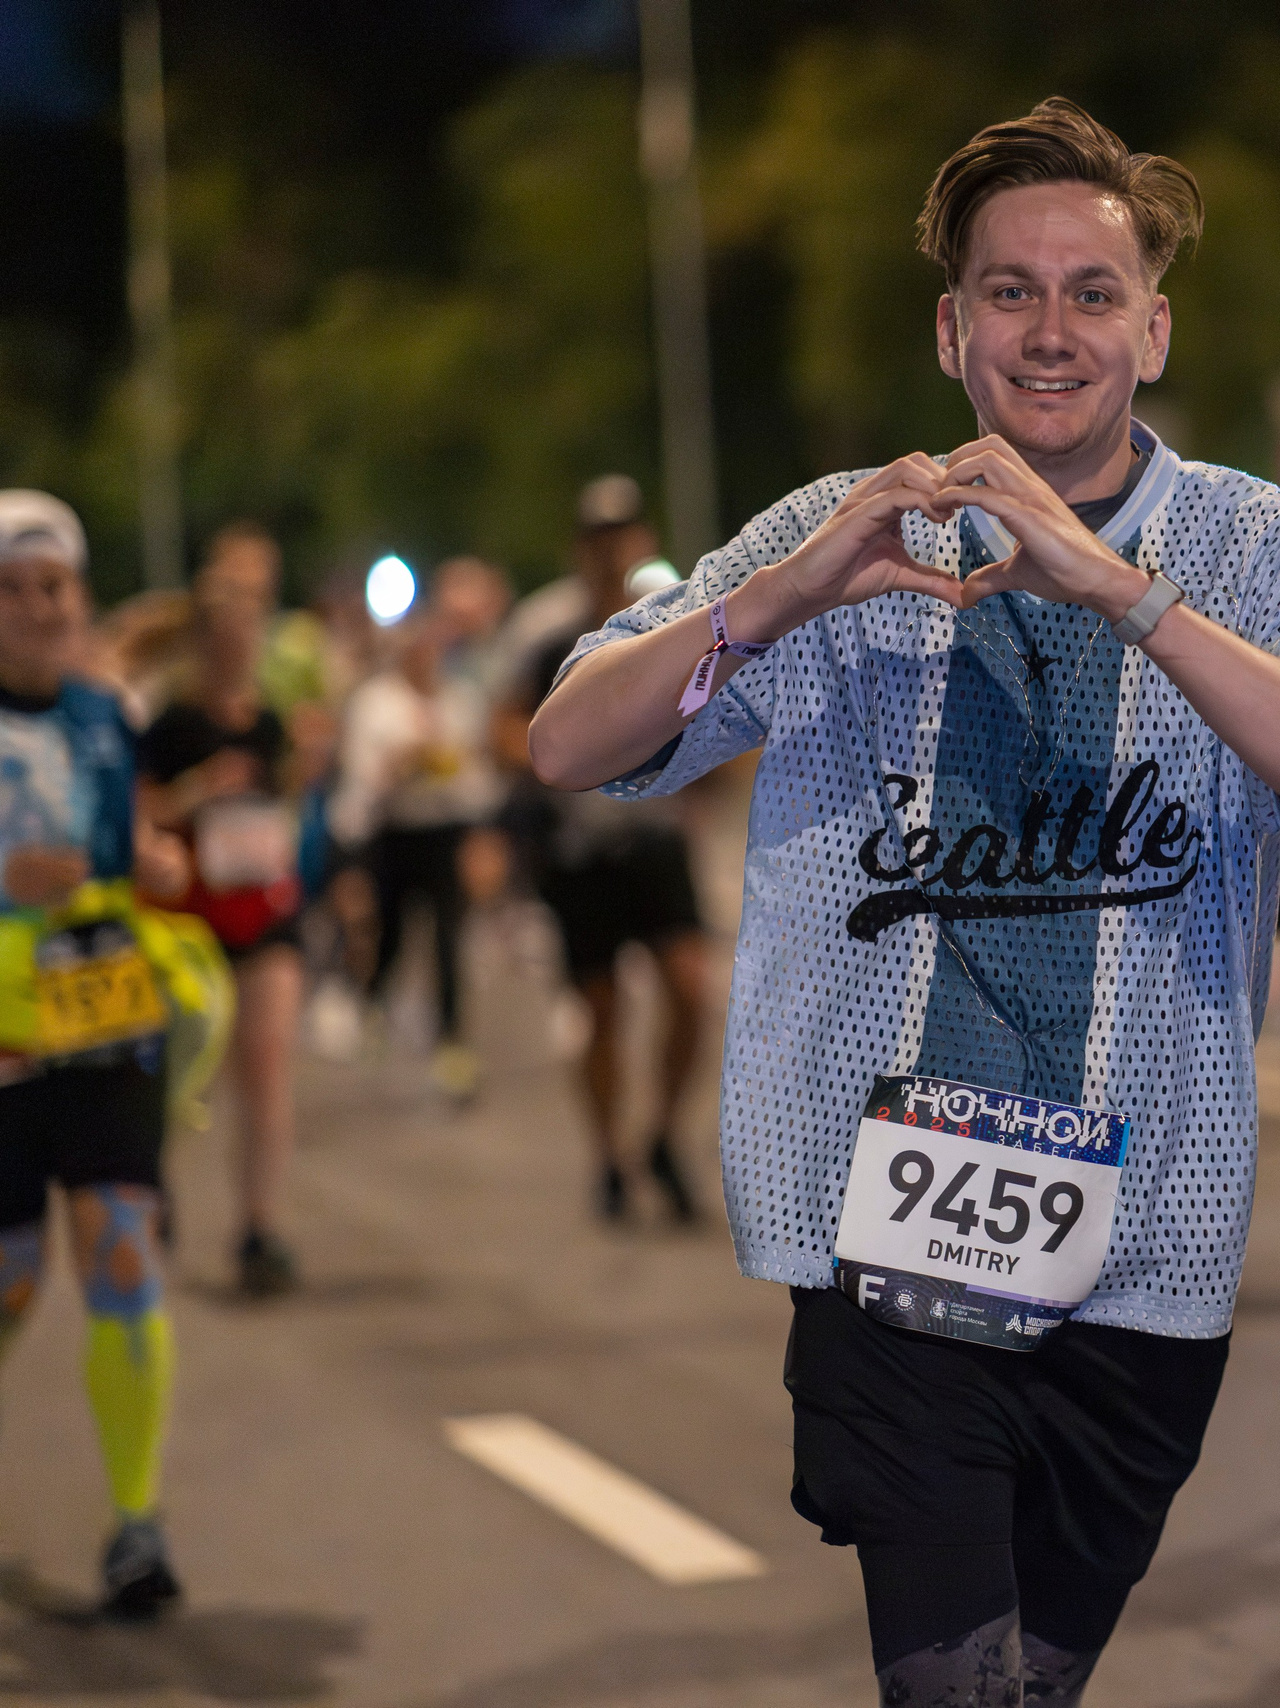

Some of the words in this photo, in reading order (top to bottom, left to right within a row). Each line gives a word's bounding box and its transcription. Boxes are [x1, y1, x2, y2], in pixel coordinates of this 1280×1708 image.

[858, 758, 1188, 890] Seattle
[900, 1077, 1111, 1151] НОЧНОЙ
[997, 1135, 1078, 1160] ЗАБЕГ
[888, 1150, 1084, 1254] 9459
[927, 1239, 1021, 1275] DMITRY
[858, 1273, 886, 1310] F
